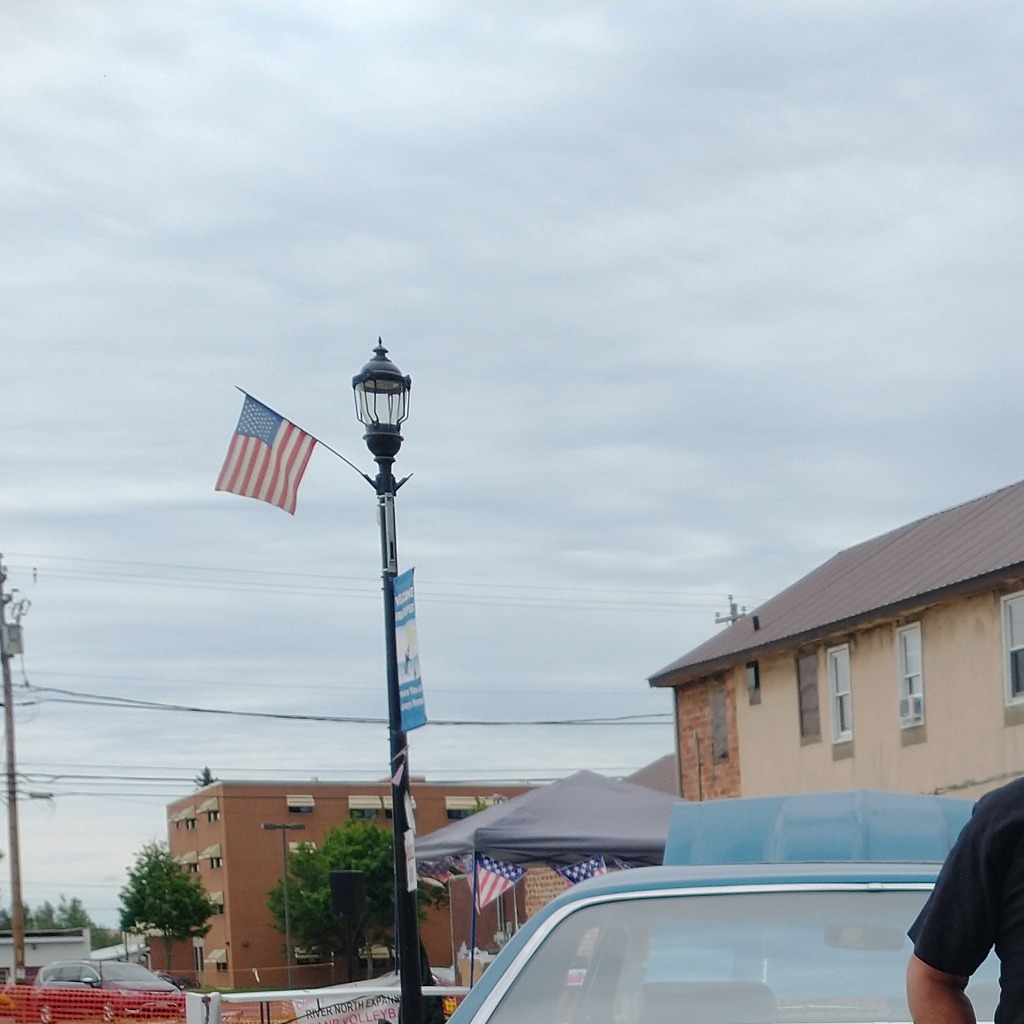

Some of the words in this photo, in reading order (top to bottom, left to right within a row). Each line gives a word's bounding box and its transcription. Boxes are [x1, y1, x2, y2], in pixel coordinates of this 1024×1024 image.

[306, 1006, 333, 1019] RIVER
[335, 1001, 364, 1015] NORTH
[366, 994, 400, 1009] EXPANS
